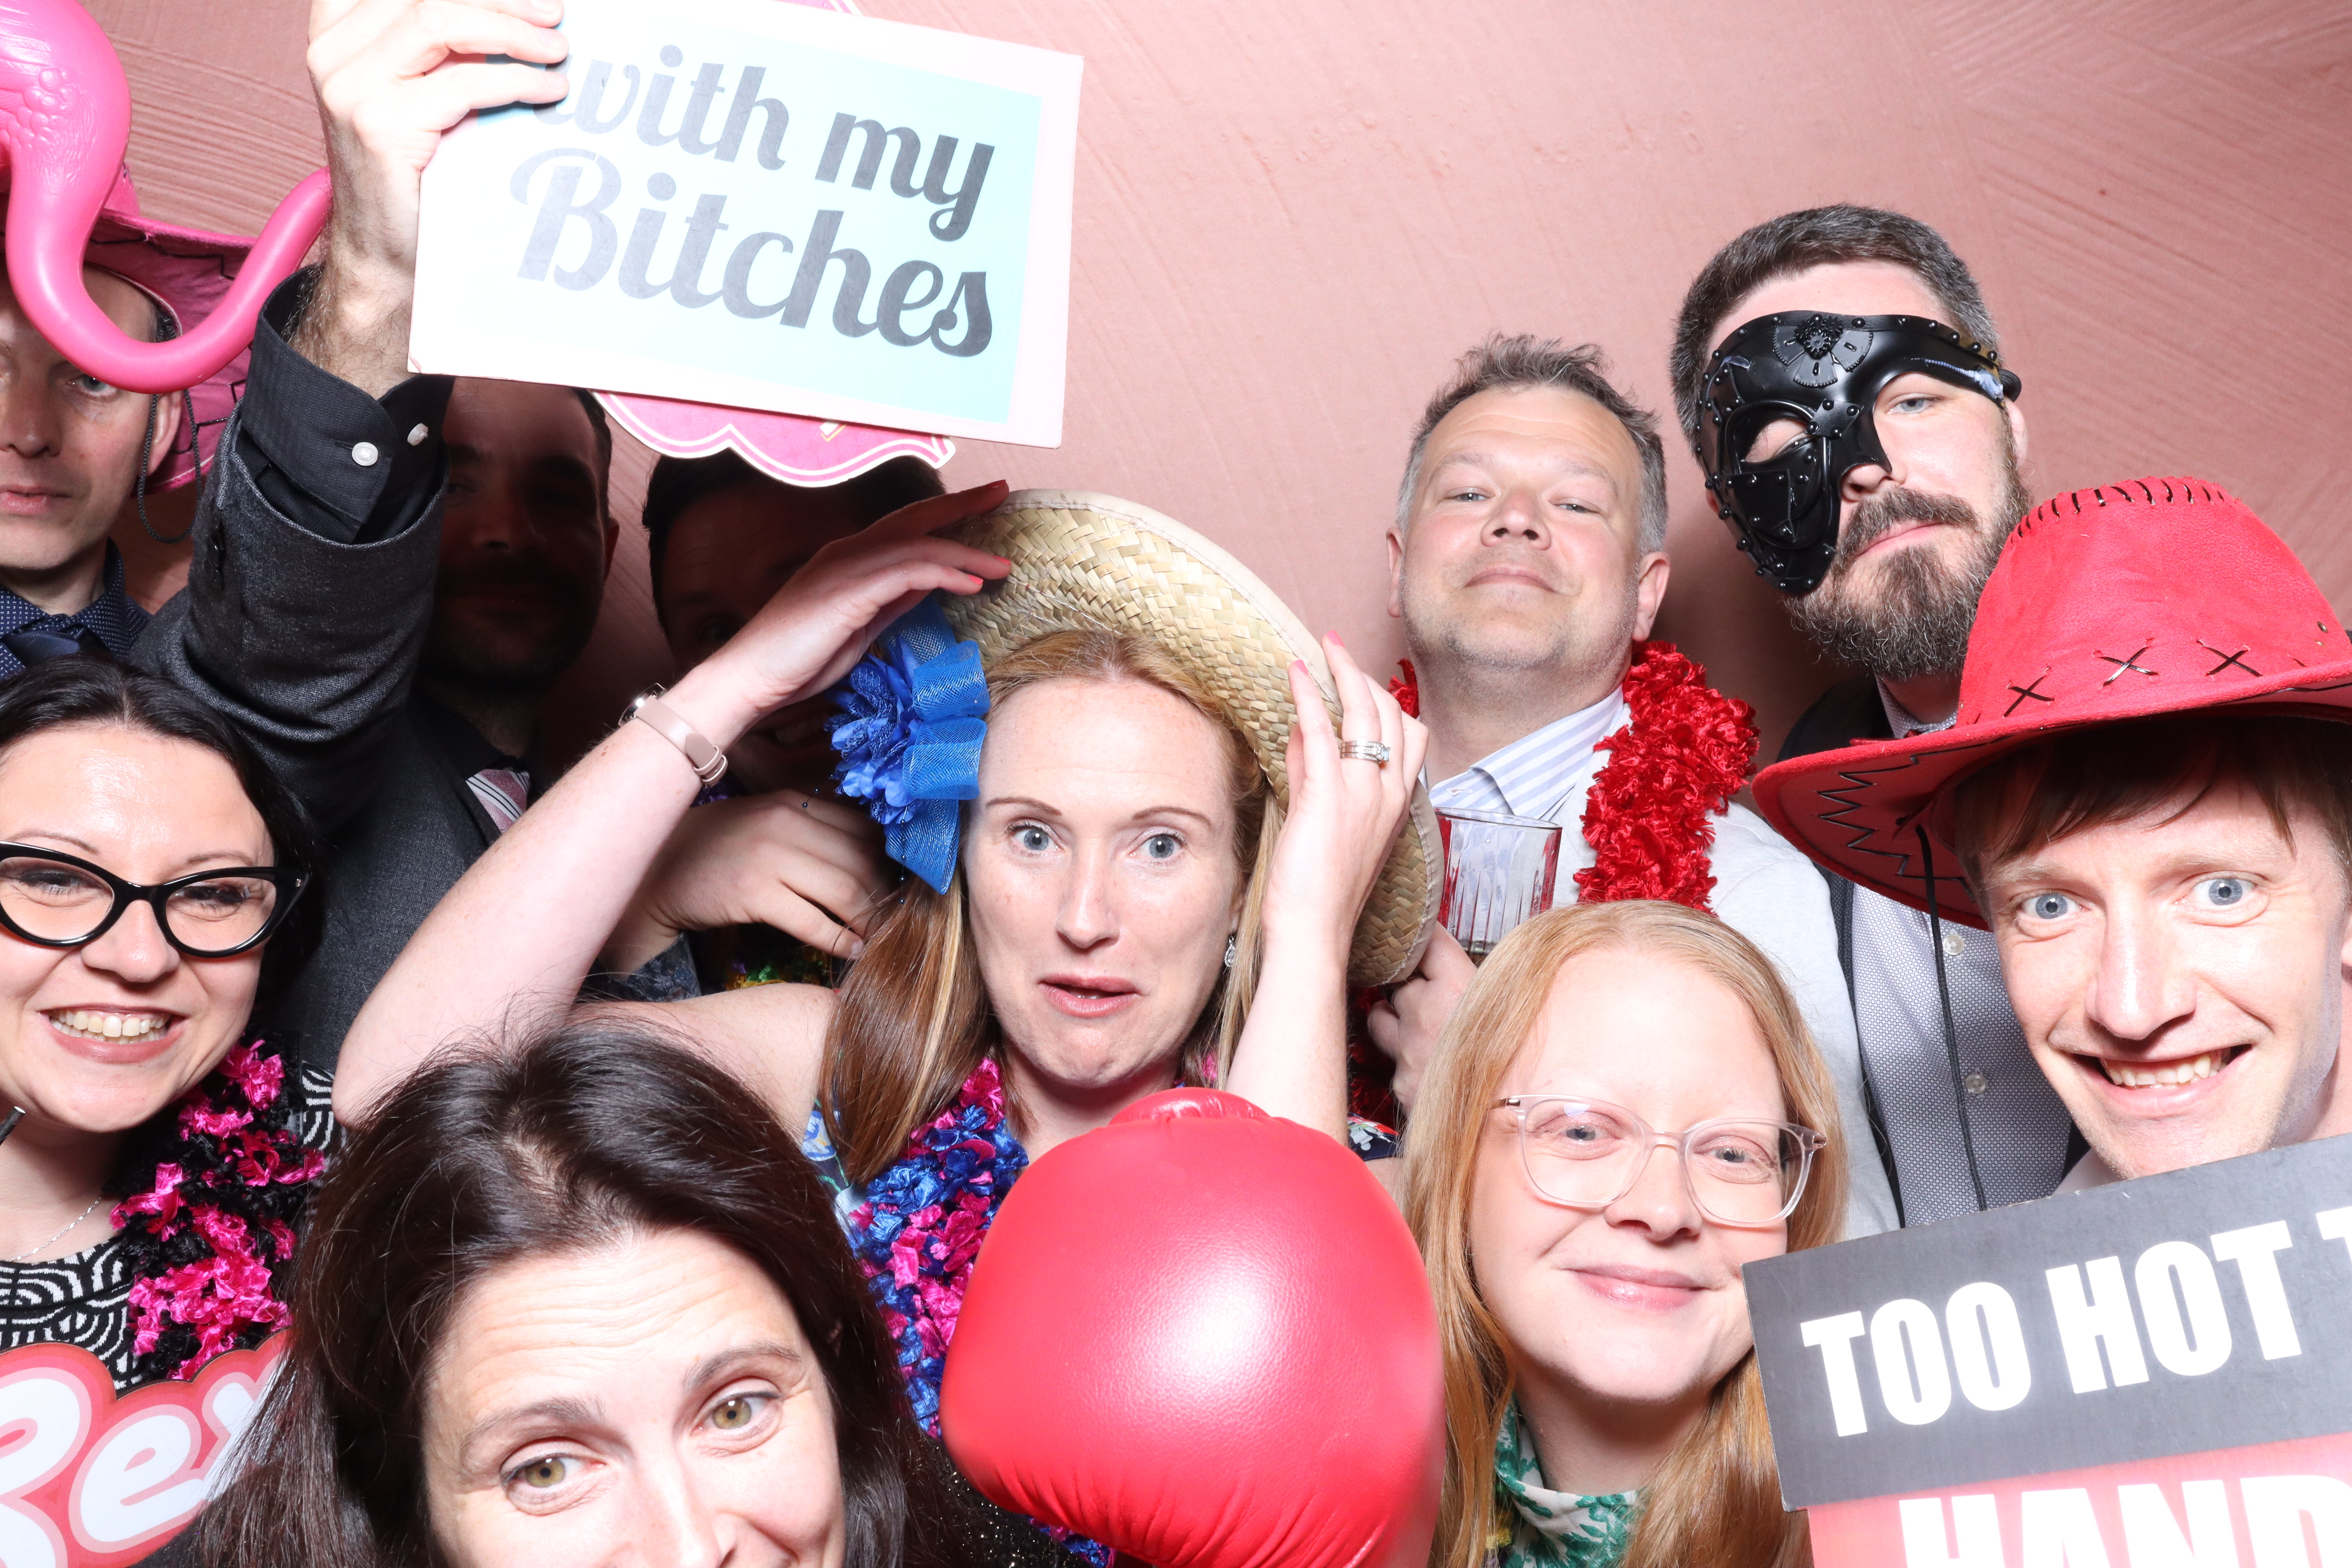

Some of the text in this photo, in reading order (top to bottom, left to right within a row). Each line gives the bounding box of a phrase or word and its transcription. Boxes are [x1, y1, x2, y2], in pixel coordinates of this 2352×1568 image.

[533, 44, 995, 242] with my
[510, 147, 993, 358] Bitches
[1800, 1220, 2302, 1436] TOO HOT
